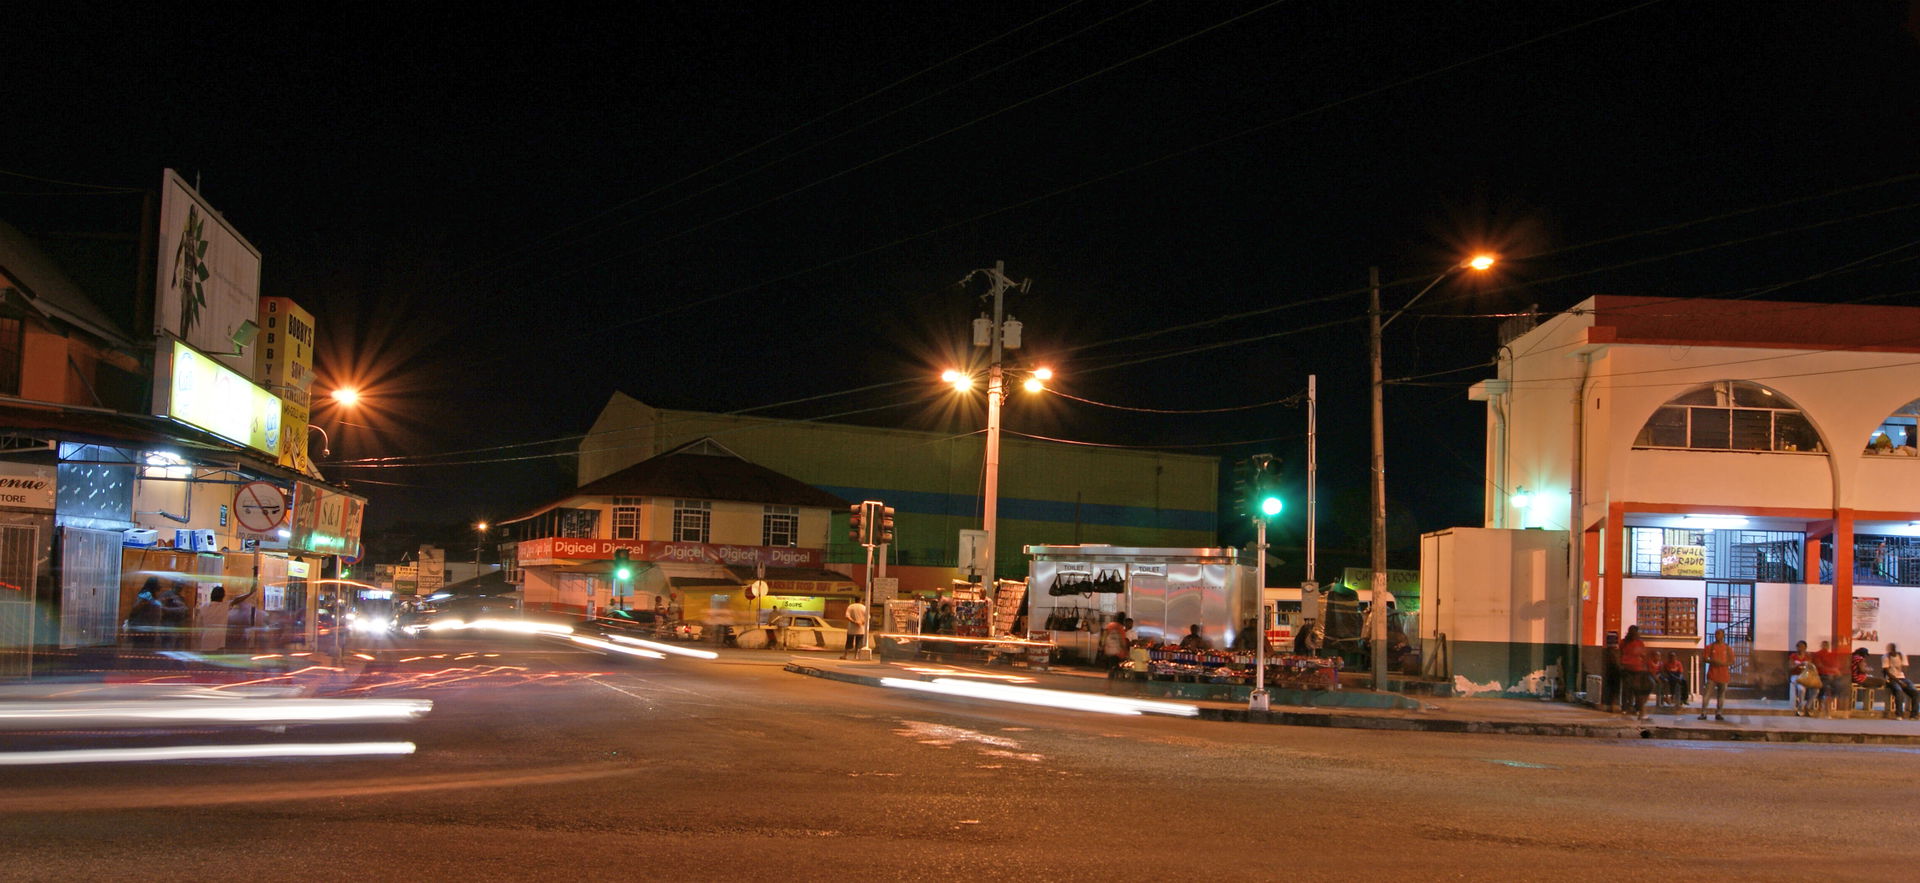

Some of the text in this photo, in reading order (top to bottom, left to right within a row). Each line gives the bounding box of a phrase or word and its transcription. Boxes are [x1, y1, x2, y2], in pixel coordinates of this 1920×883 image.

[555, 541, 596, 555] Digicel
[602, 542, 644, 556] Dicel
[665, 544, 704, 560] Digicel
[719, 547, 758, 561] Digicel
[772, 550, 810, 564] Digicel
[1663, 547, 1704, 556] SIDEWALK
[1679, 557, 1704, 565] RADIO
